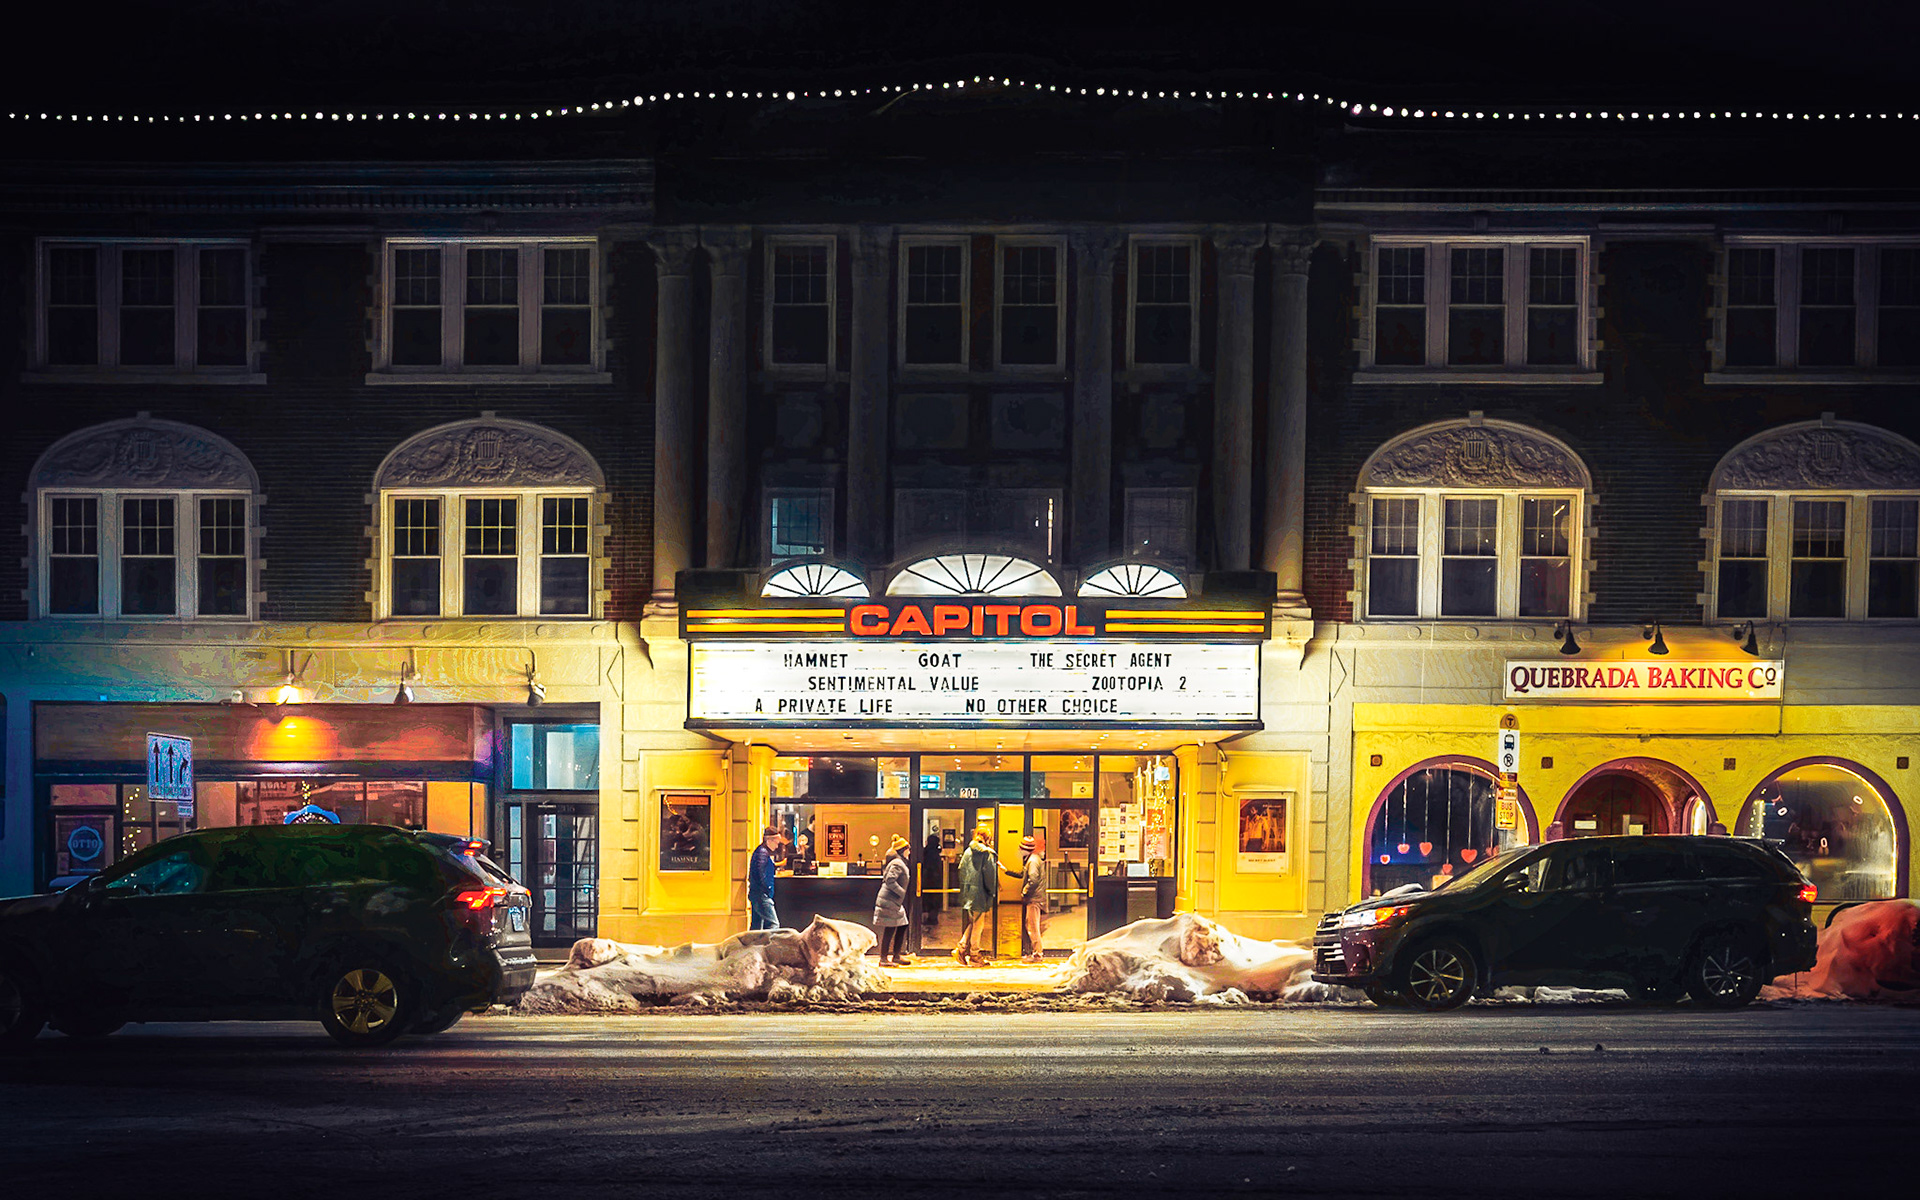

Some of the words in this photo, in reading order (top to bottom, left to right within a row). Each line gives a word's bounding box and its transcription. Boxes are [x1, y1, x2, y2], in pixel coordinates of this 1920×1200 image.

[850, 604, 1096, 636] CAPITOL
[784, 653, 848, 668] HAMNET
[918, 653, 962, 668] GOAT
[1030, 653, 1054, 668] THE
[1066, 653, 1117, 668] SECRET
[1130, 653, 1172, 668] AGENT
[808, 676, 916, 691] SENTIMENTAL
[930, 676, 979, 691] VALUE
[1092, 676, 1163, 691] ZOOTOPIA
[1179, 676, 1187, 690] 2
[1510, 666, 1640, 693] QUEBRADA
[1647, 666, 1743, 689] BAKING
[755, 698, 763, 713] A
[778, 698, 847, 713] PRIVATE
[860, 698, 893, 713] LIFE
[966, 698, 986, 713] NO
[997, 698, 1047, 713] OTHER
[1062, 698, 1118, 713] CHOICE
[961, 789, 977, 798] 204
[1501, 802, 1513, 810] BUS
[1499, 811, 1514, 819] STOP
[72, 839, 98, 848] OTTO
